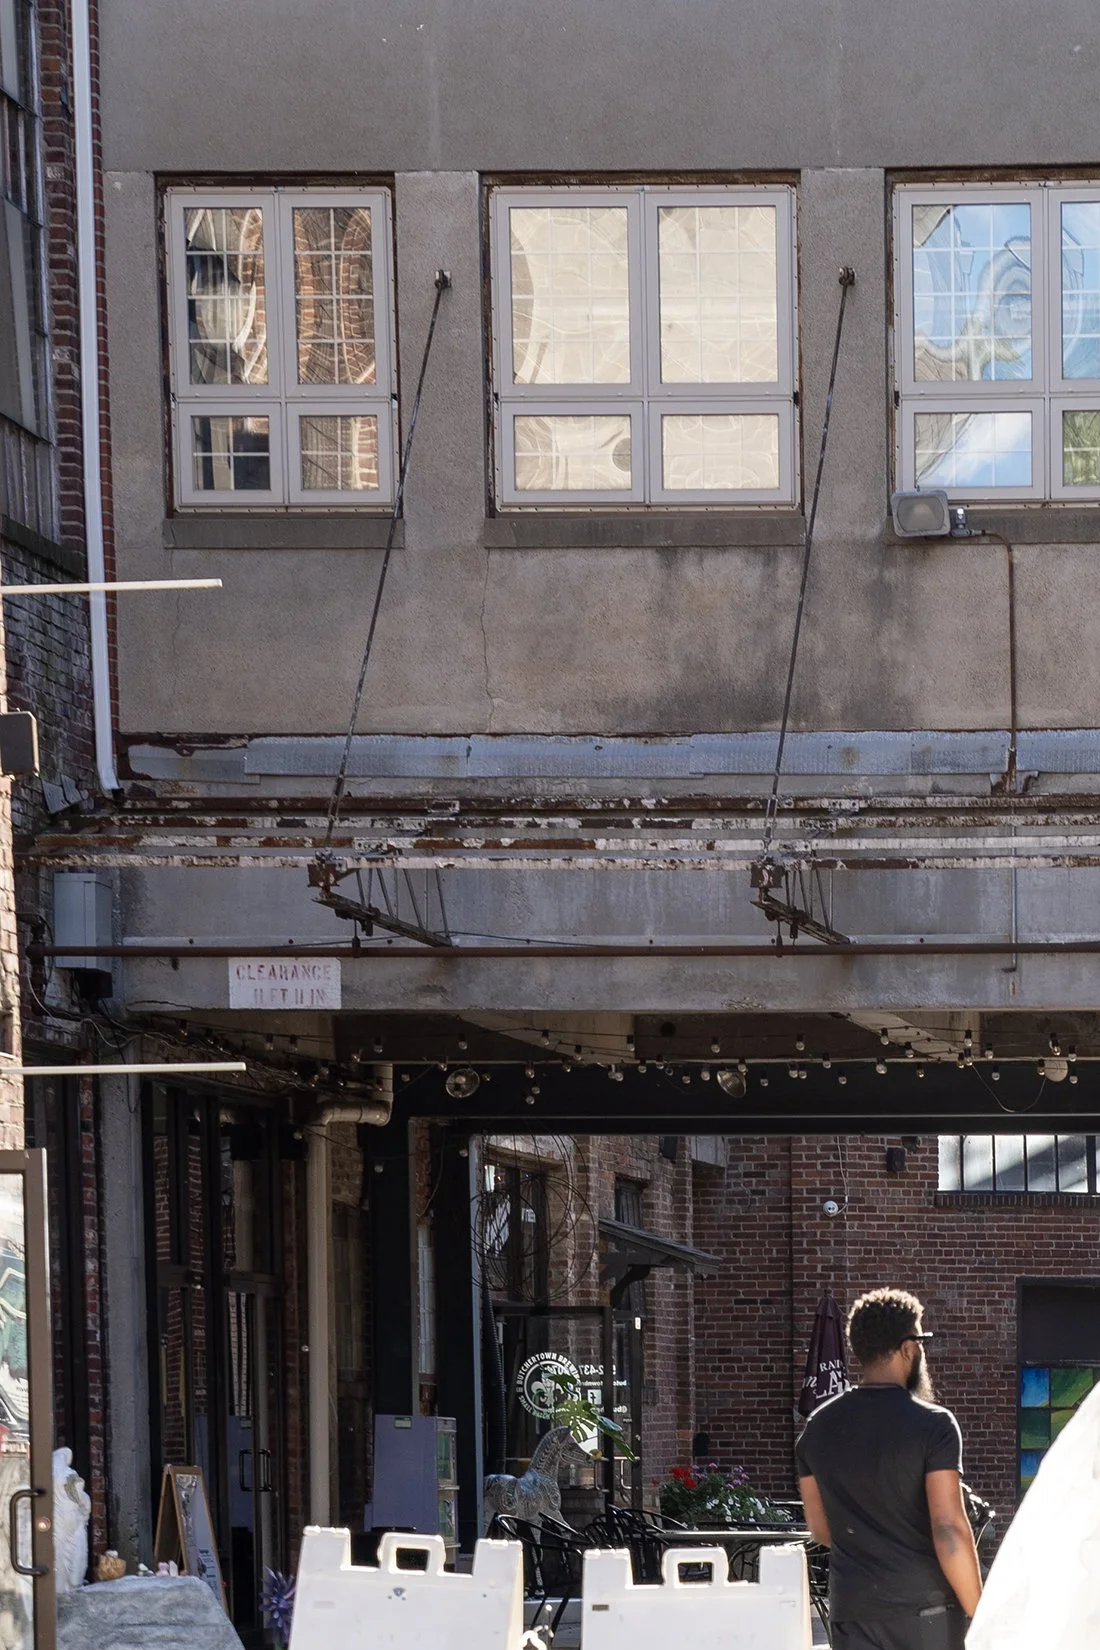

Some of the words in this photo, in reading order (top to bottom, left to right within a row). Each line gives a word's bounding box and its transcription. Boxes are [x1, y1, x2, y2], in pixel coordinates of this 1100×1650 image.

[236, 964, 331, 981] CLEARANCE
[271, 988, 288, 1004] FT
[310, 988, 327, 1004] IN
[516, 1352, 558, 1385] BUTCHERTOWN
